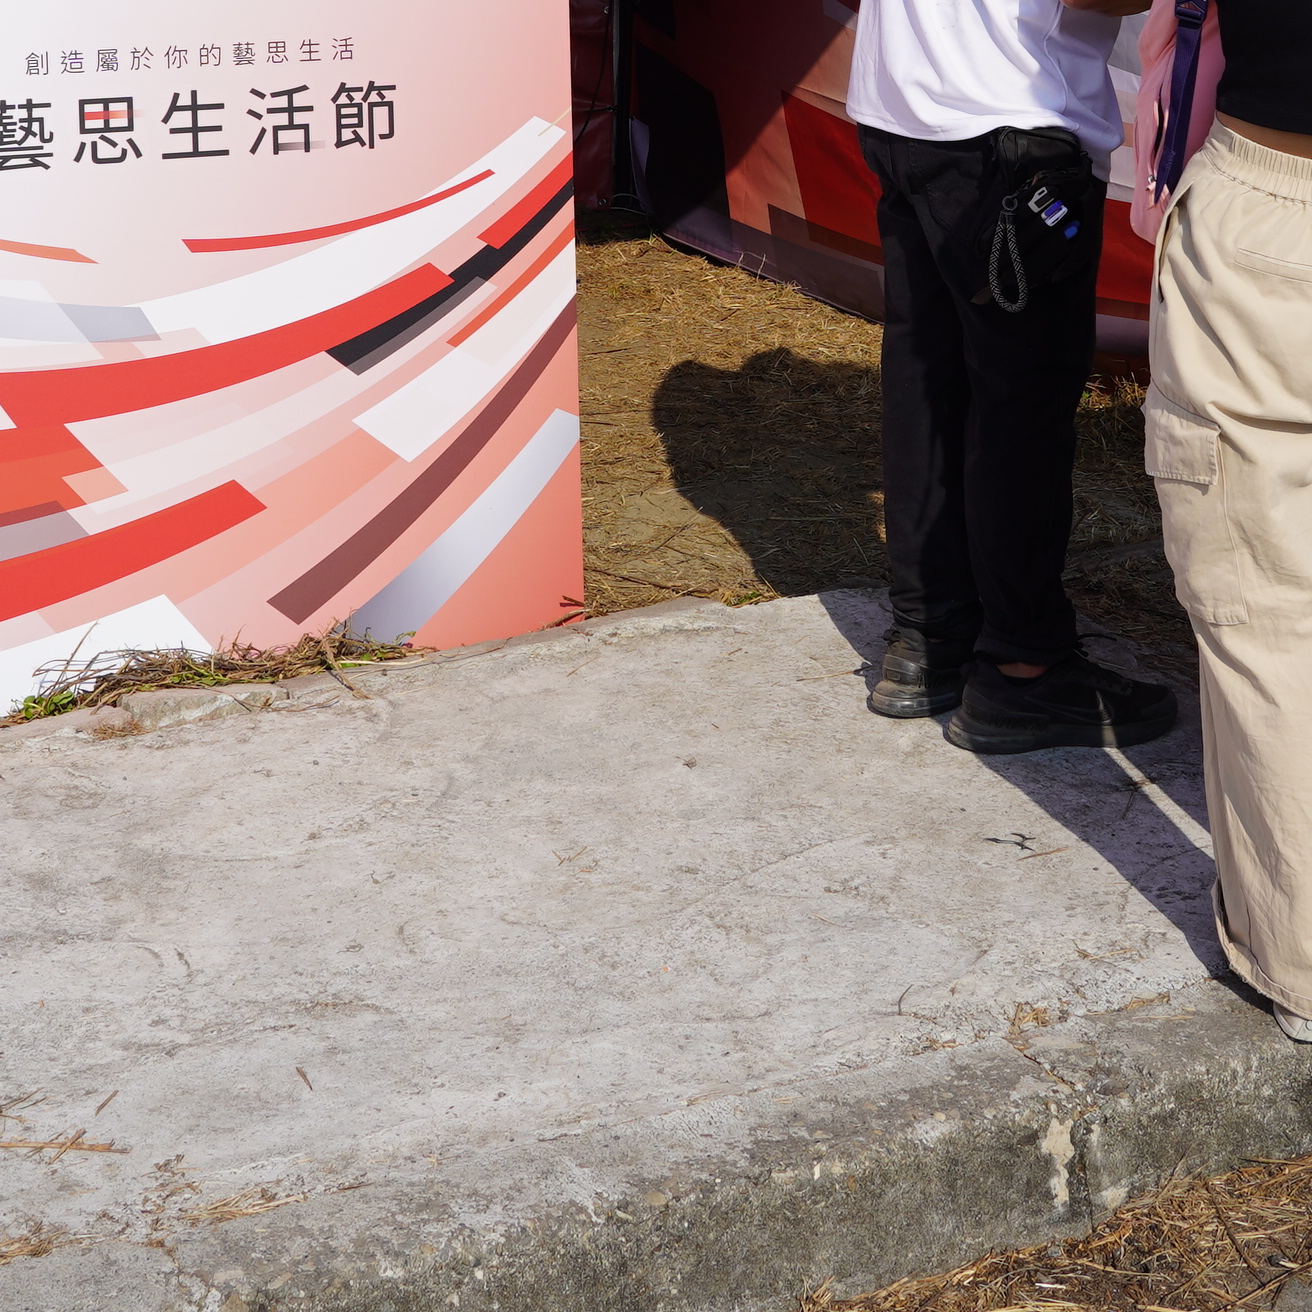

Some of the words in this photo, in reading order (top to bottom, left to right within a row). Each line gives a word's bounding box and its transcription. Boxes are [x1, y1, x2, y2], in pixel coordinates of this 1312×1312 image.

[25, 37, 357, 76] 創造屬於你的藝思生活
